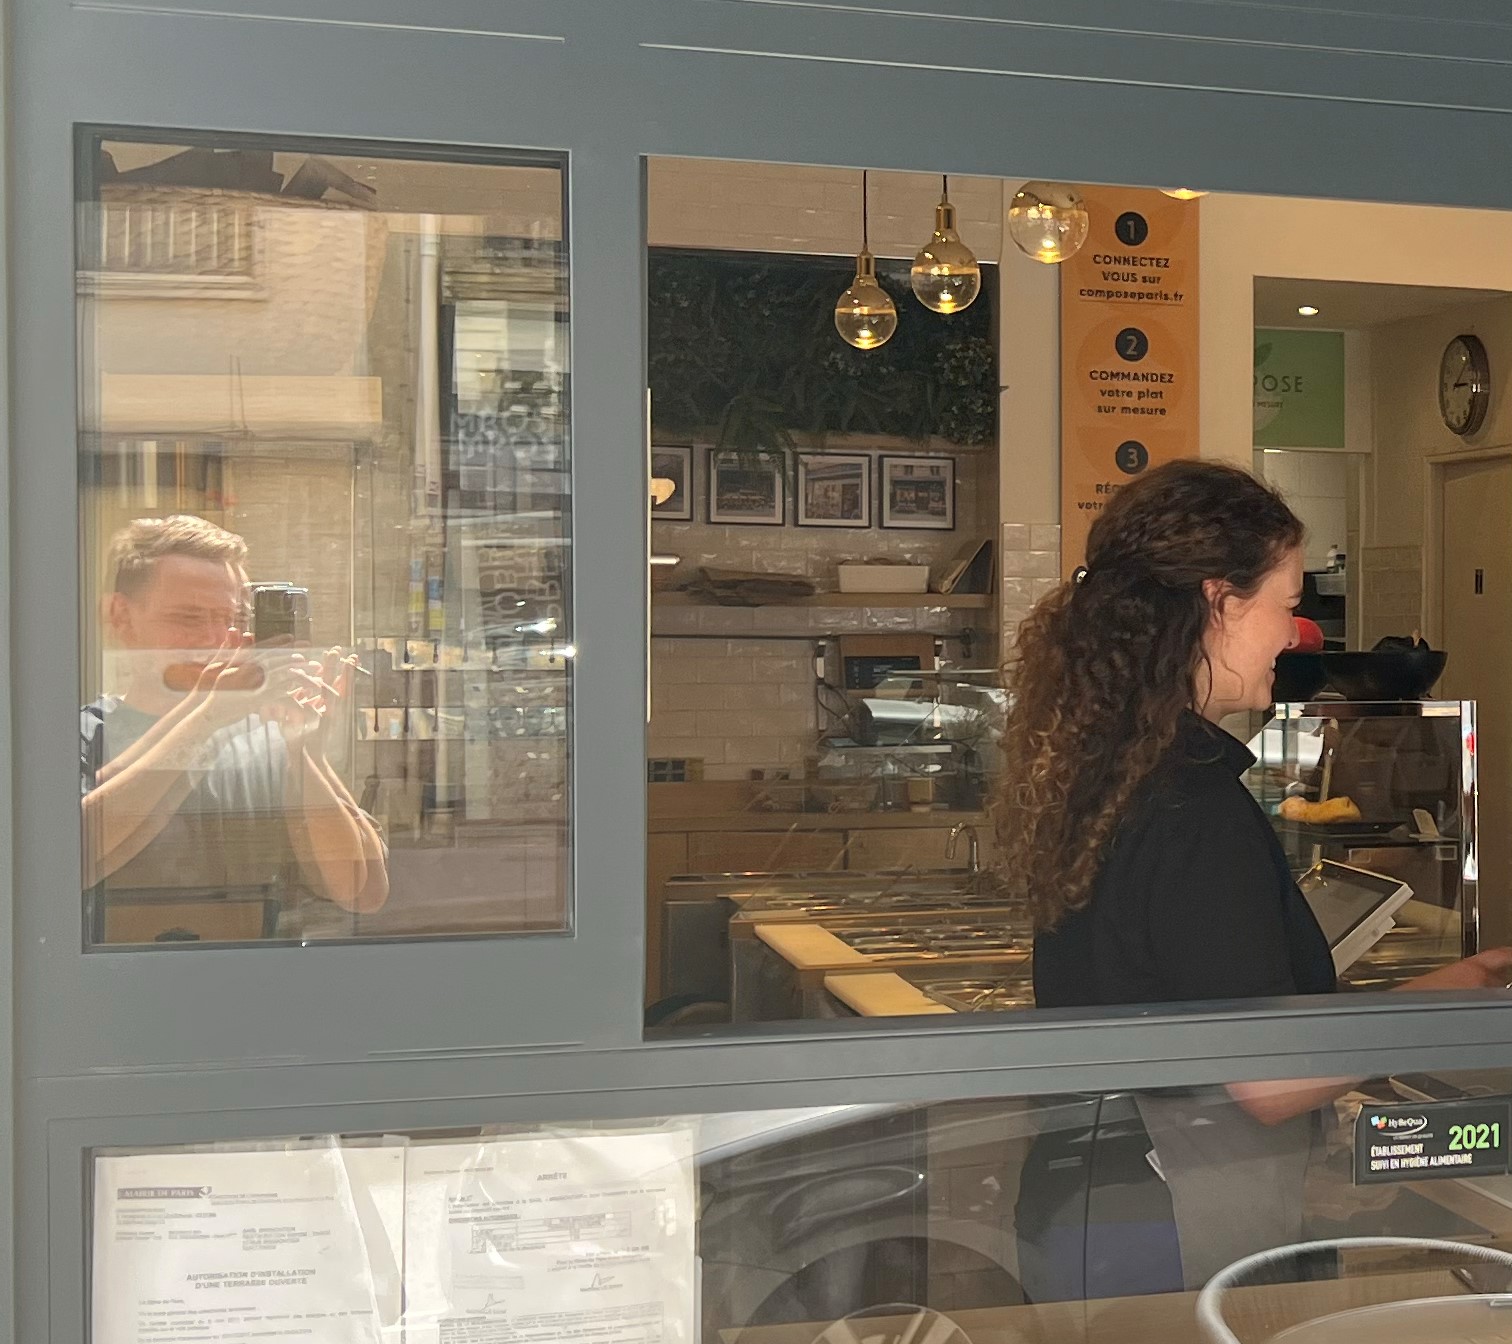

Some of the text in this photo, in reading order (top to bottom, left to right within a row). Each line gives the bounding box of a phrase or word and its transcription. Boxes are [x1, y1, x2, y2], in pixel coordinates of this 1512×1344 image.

[1126, 220, 1136, 239] 1
[1092, 254, 1170, 269] CONNECTEZ
[1101, 271, 1161, 286] VOUS sur
[1126, 336, 1137, 355] 2
[1089, 370, 1174, 384] COMMANDEZ
[1100, 387, 1164, 400] votre plat
[1096, 405, 1166, 417] sur mesure
[1127, 448, 1138, 467] 3
[1448, 1123, 1500, 1151] 2021
[186, 1270, 248, 1282] AUTORISATION
